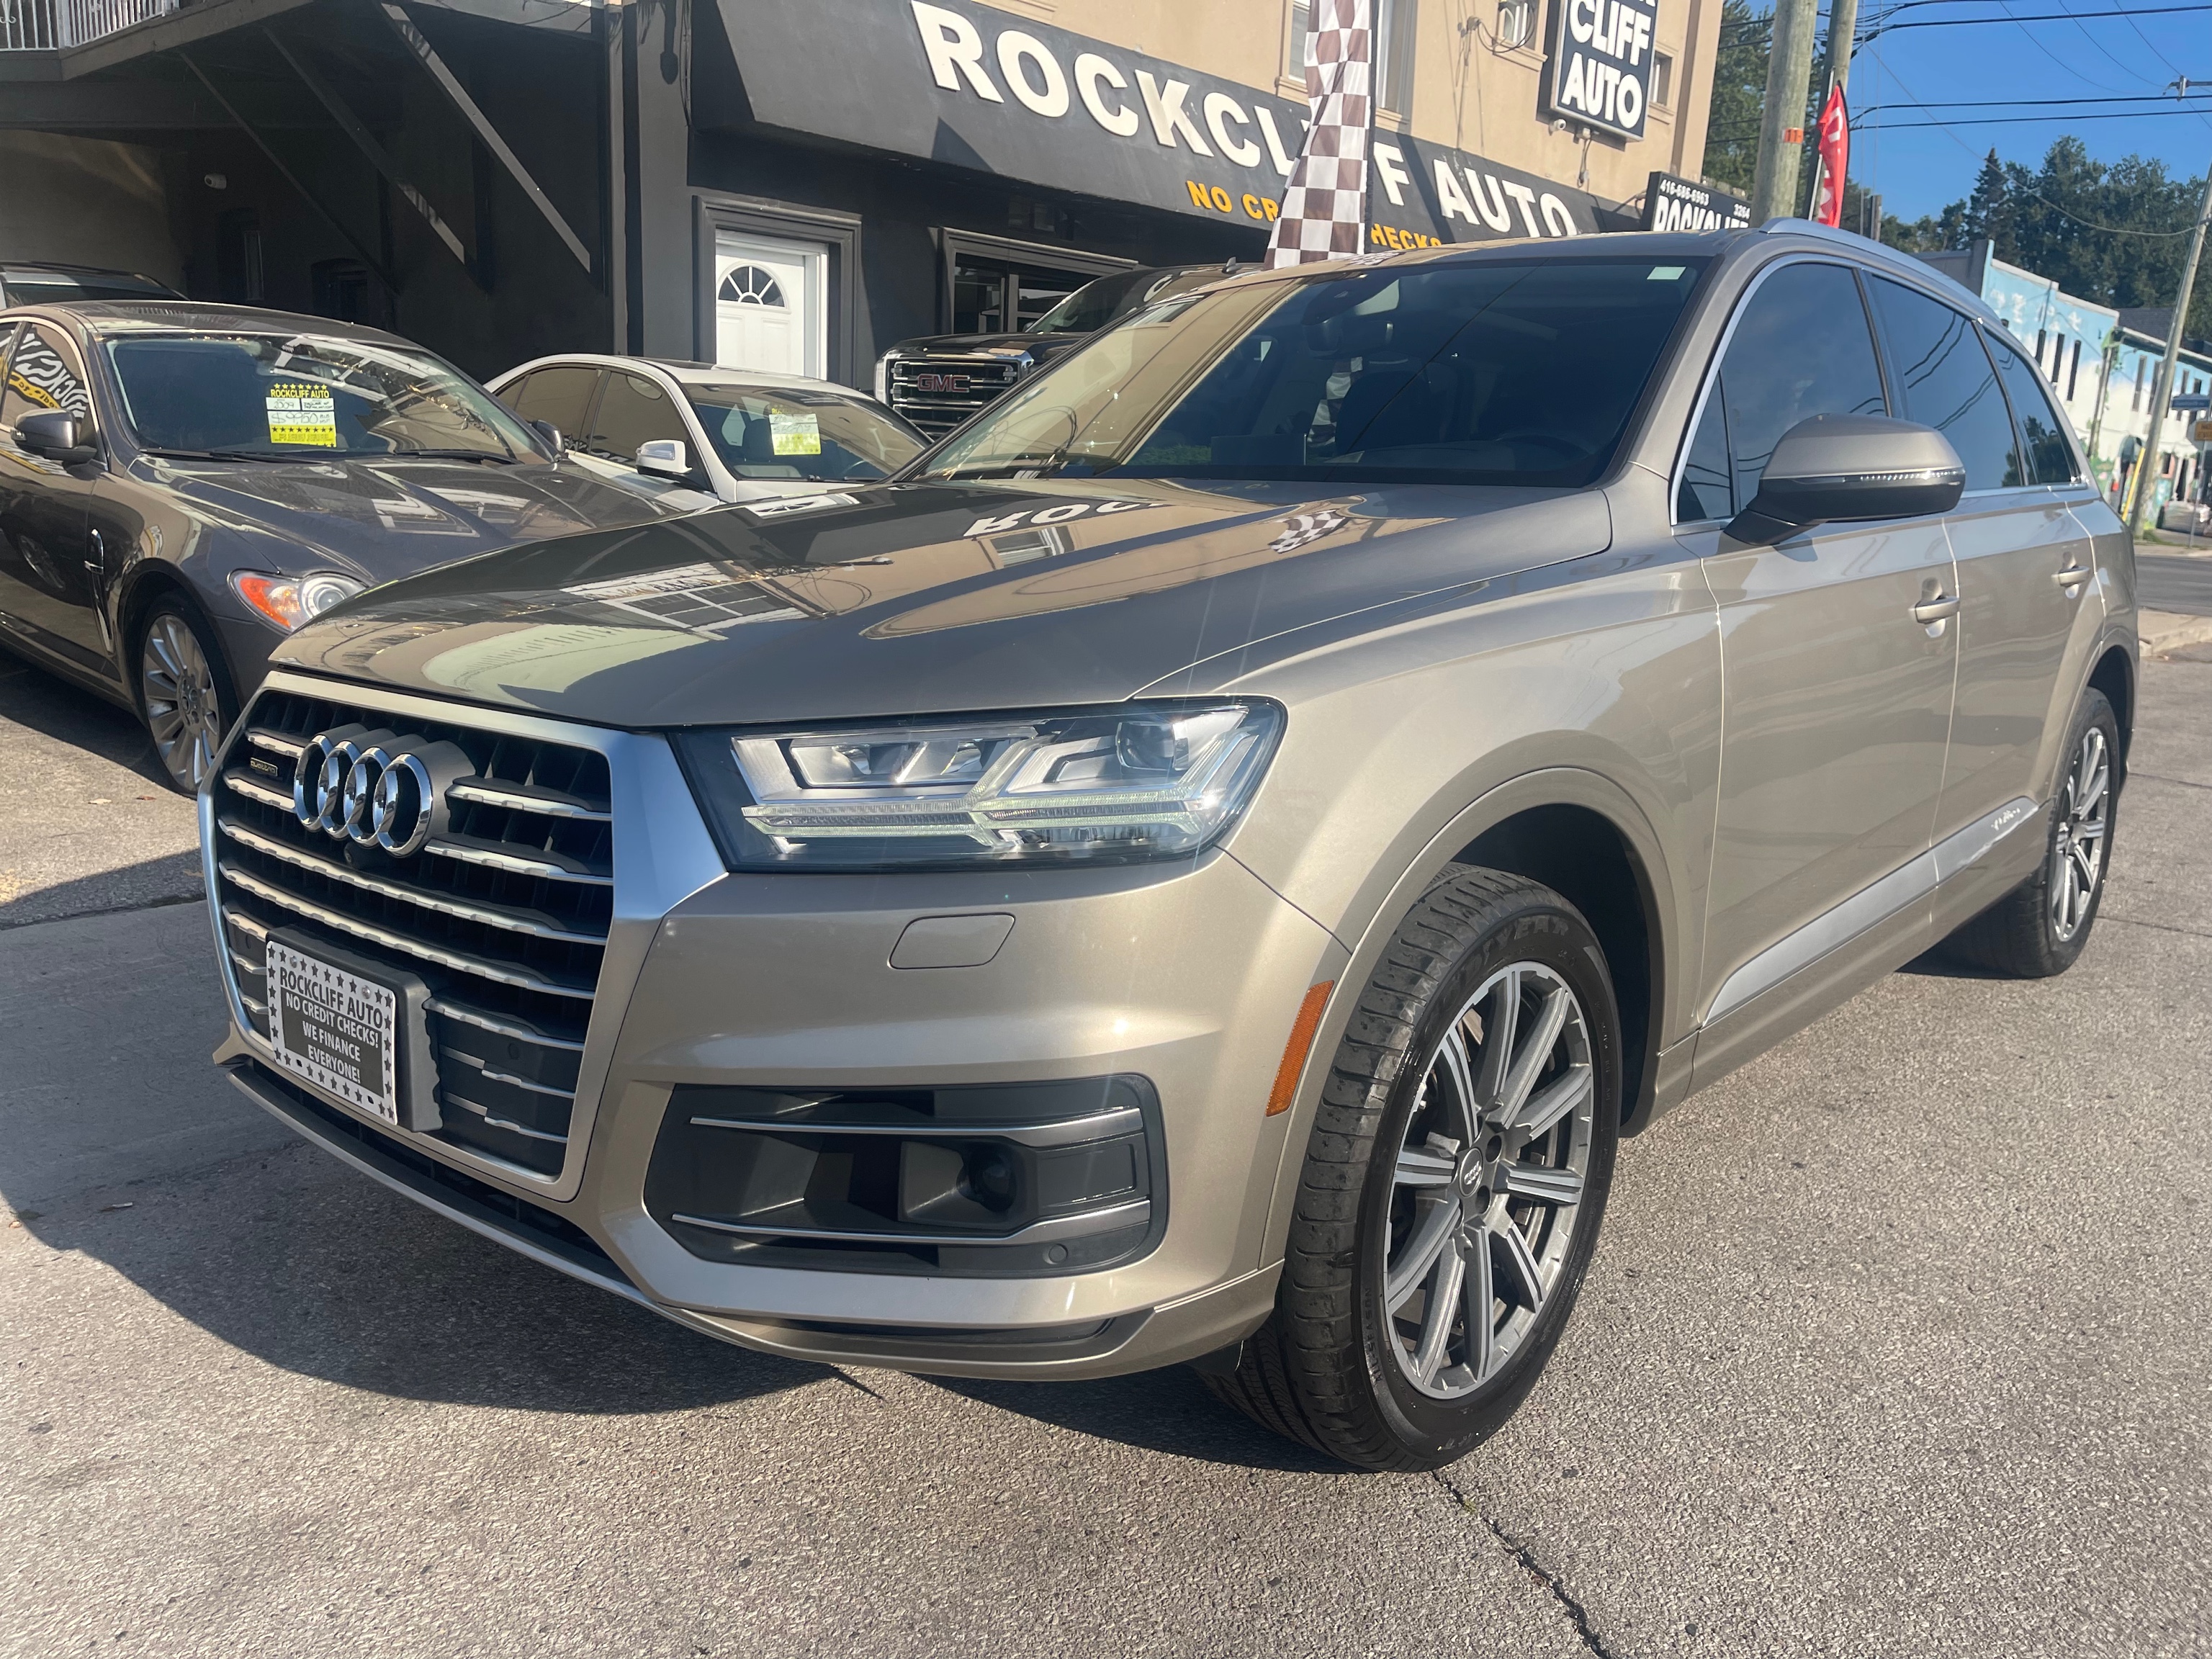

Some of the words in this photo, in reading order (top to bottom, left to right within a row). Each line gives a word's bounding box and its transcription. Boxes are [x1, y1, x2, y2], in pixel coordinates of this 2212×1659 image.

[1569, 0, 1652, 66] CLIFF
[911, 0, 1409, 206] ROCKCLF
[1432, 158, 1577, 238] AUTO
[1561, 51, 1643, 129] AUTO
[1186, 180, 1232, 213] NO
[1371, 223, 1442, 251] HECK
[270, 389, 310, 397] ROCKCLIFF
[310, 390, 330, 398] AUTO
[917, 373, 971, 392] GMC
[280, 966, 343, 1012] ROCKCLIFF
[347, 997, 383, 1029] AUTO
[286, 992, 301, 1011] NO
[302, 999, 336, 1028] CREDIT
[337, 1015, 379, 1048] CHECKS!
[302, 1020, 318, 1041] WE
[319, 1028, 361, 1062] FINANCE
[307, 1044, 361, 1084] EVERYONE!
